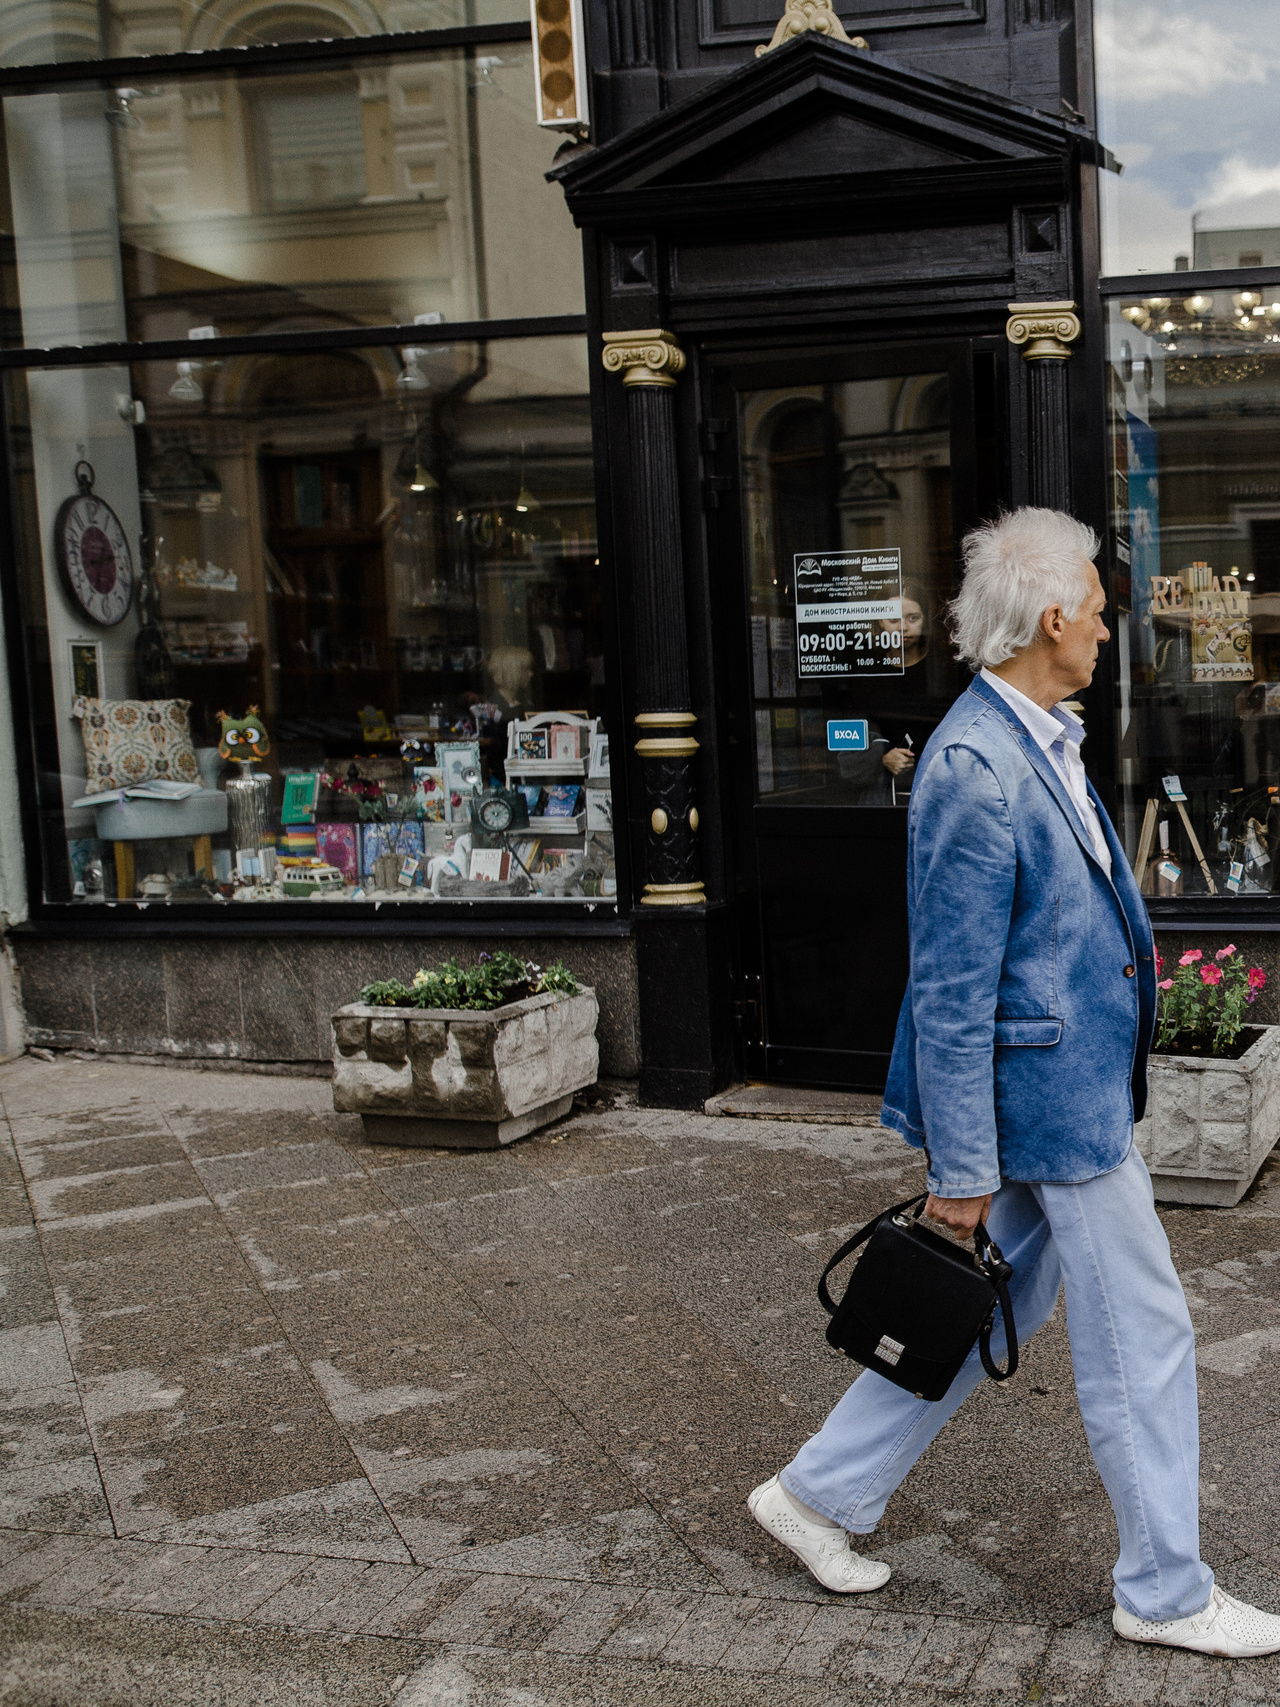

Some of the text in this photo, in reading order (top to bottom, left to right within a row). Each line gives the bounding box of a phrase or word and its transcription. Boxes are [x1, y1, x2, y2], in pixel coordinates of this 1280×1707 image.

[821, 555, 899, 567] Московский Дом Книги
[804, 609, 820, 617] ДОМ
[870, 606, 894, 614] КНИГИ
[845, 622, 872, 631] работы:
[800, 631, 901, 652] 09:00-21:00
[801, 655, 831, 663] СУББОТА
[856, 658, 874, 666] 10:00
[883, 657, 901, 665] 20:00
[520, 733, 532, 742] 100
[834, 729, 860, 740] ВХОД
